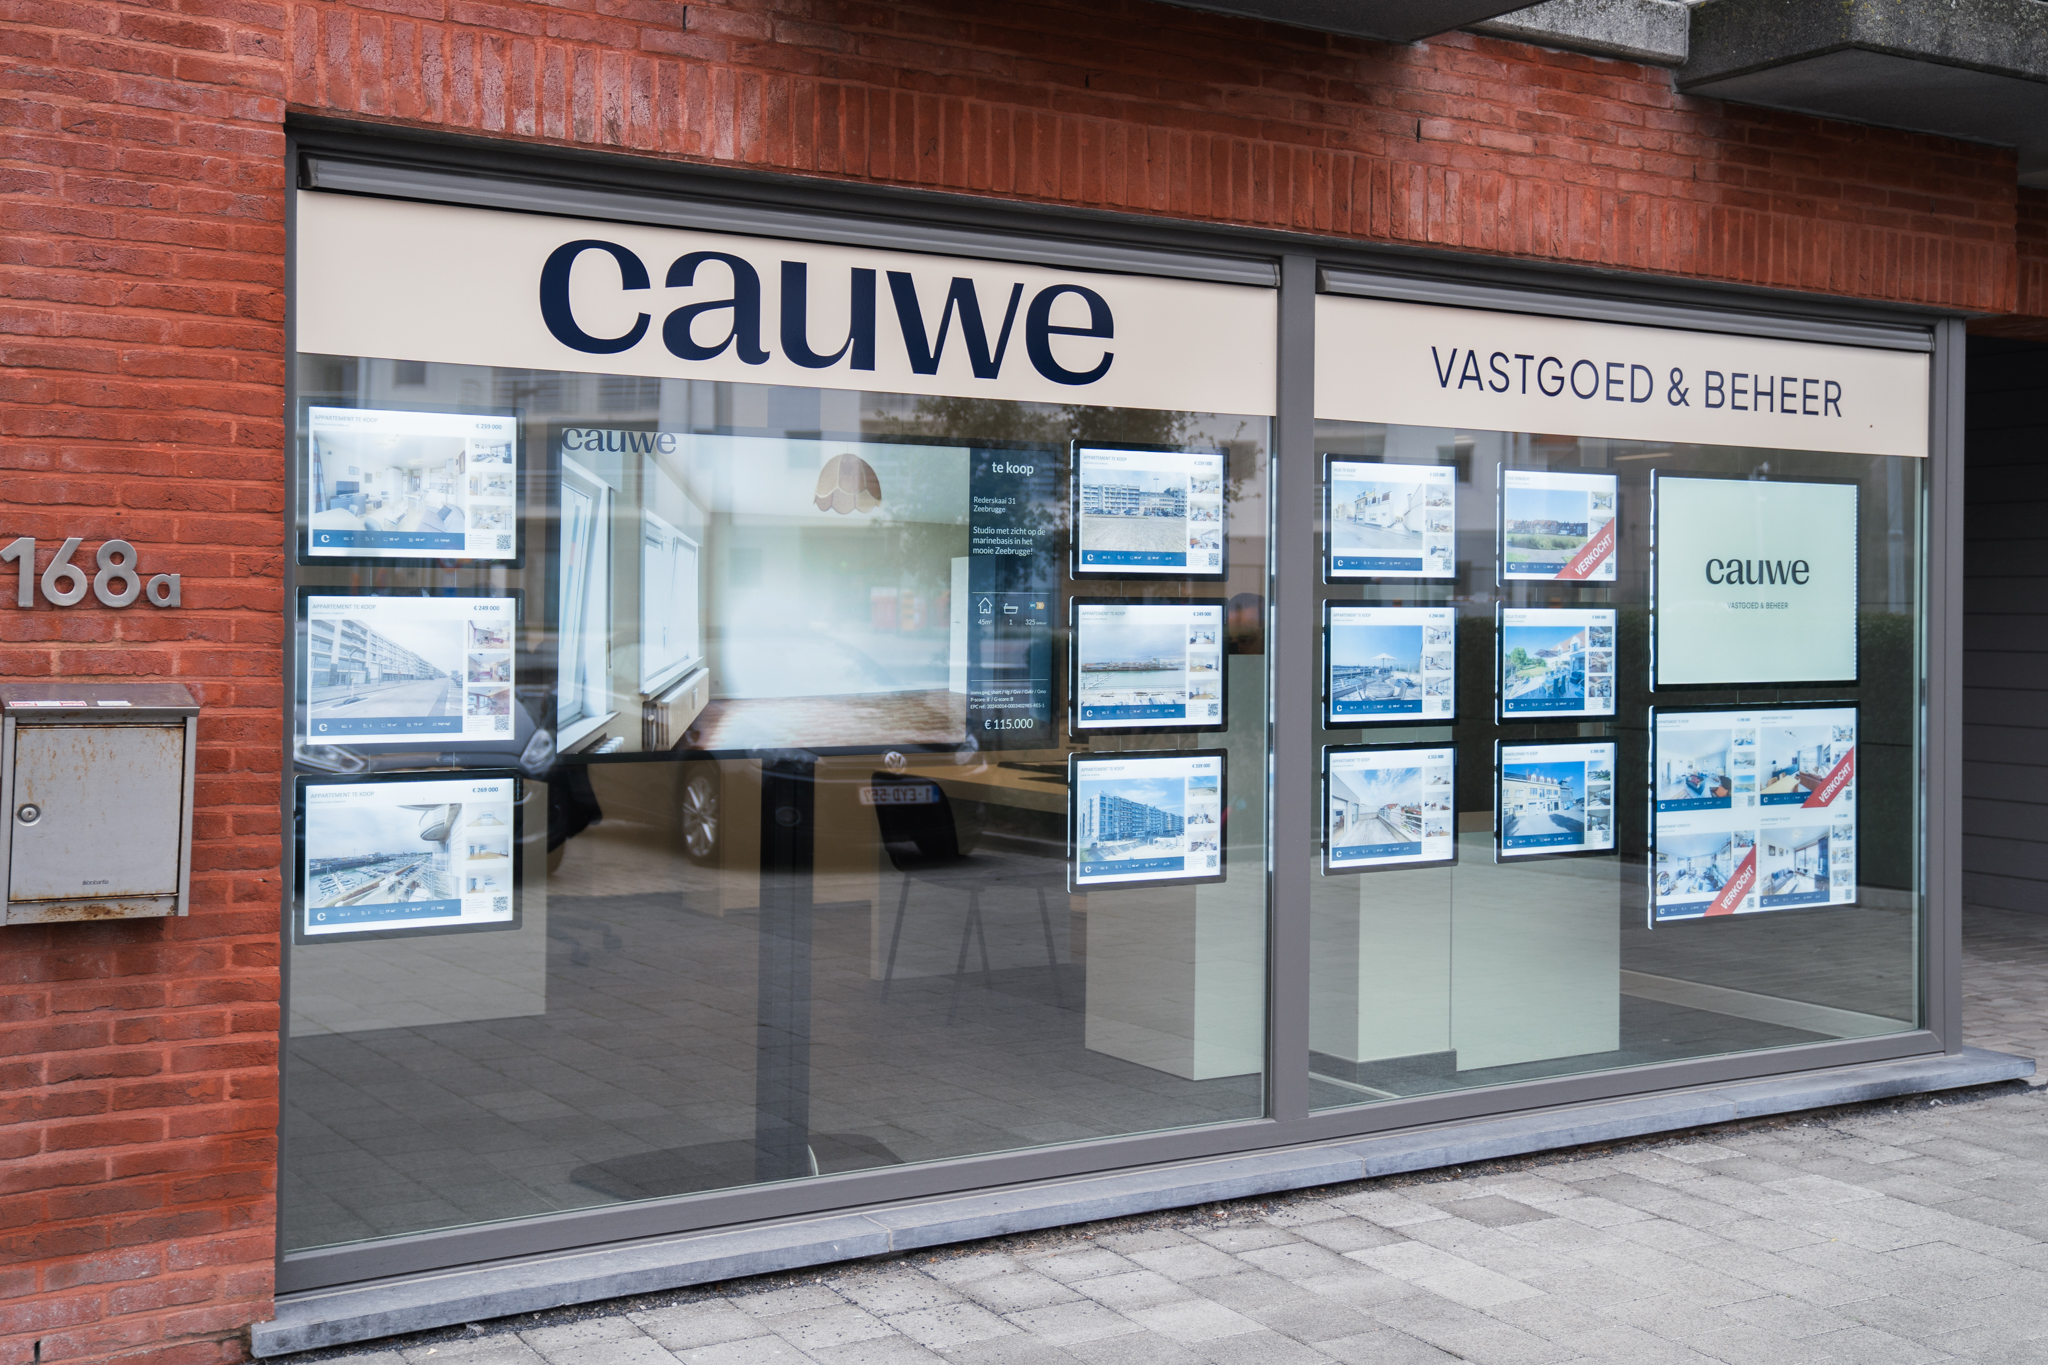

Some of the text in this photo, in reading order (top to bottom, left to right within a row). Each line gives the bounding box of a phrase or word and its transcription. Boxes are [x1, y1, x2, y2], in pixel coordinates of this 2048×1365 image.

[540, 238, 1114, 386] cauwe
[1431, 346, 1842, 418] VASTGOED & BEHEER
[562, 428, 676, 454] cauwe
[992, 461, 1034, 476] te koop
[973, 496, 1007, 504] Rederskaai
[973, 505, 1006, 514] Zeebrugge
[973, 526, 995, 534] Studio
[996, 527, 1009, 535] met
[973, 537, 1013, 545] marinebasis
[995, 547, 1033, 556] Zeebrugge!
[1574, 534, 1612, 576] VERKOCHT
[1705, 558, 1810, 585] cauwe
[984, 718, 1034, 730] € 115.000
[1818, 762, 1851, 803] VERKOCHT
[1720, 864, 1754, 910] VERKOCHT
